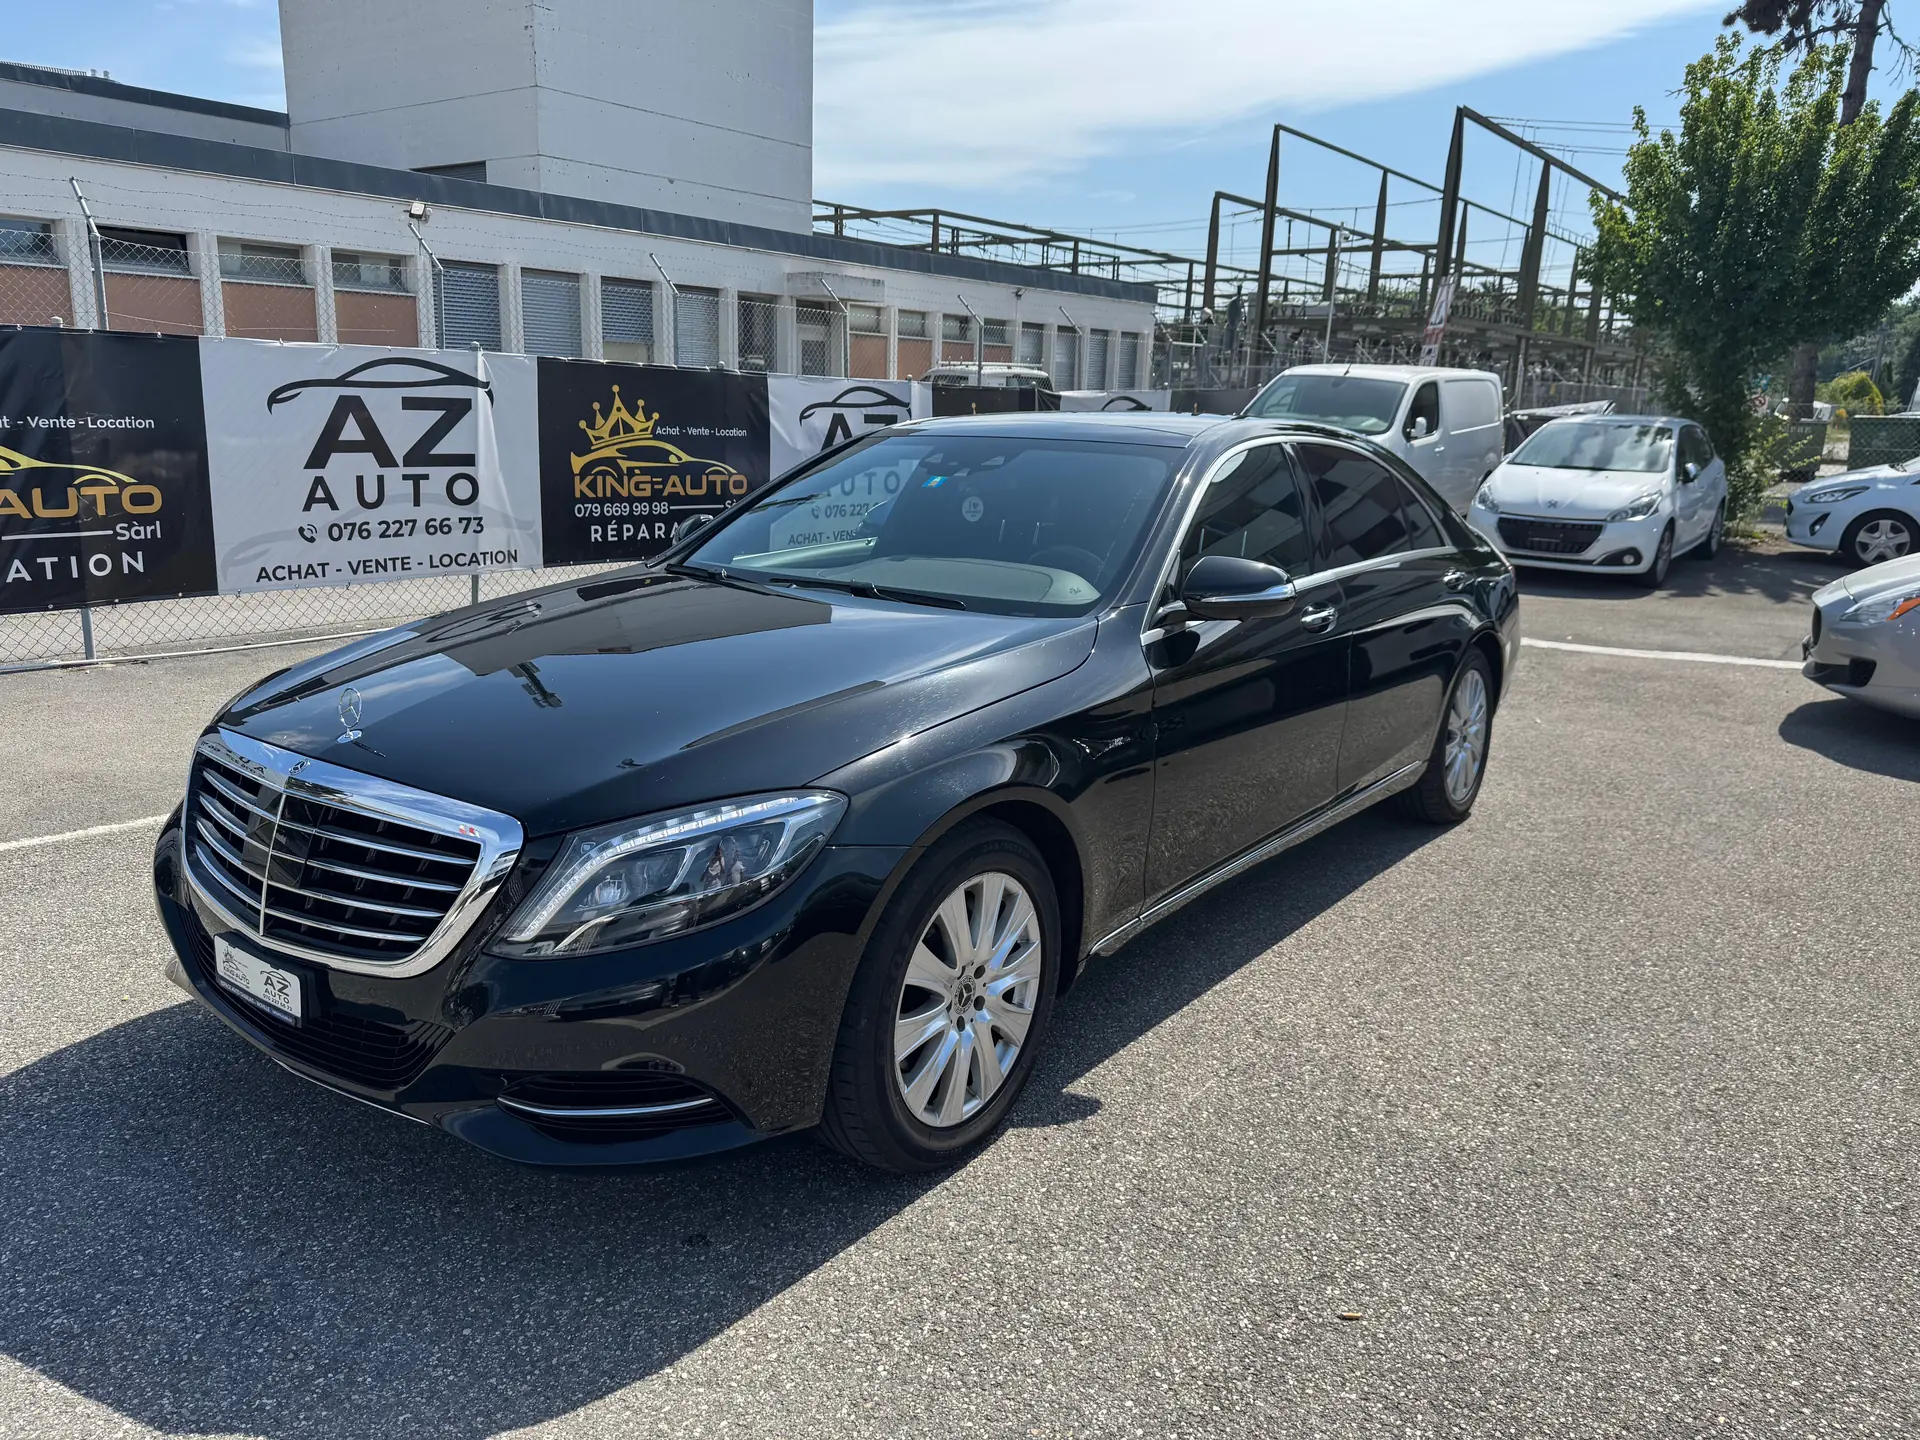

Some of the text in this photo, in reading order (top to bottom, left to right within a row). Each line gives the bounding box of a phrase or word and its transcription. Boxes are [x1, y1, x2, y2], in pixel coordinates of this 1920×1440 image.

[26, 415, 76, 429] Vente
[87, 415, 155, 429] Location
[304, 395, 476, 469] AZ
[655, 426, 680, 435] Achat
[686, 427, 710, 436] Vente
[715, 427, 747, 437] Location
[302, 472, 480, 512] AUTO
[574, 501, 669, 518] 079 669 99 98
[824, 504, 847, 519] 076
[115, 521, 162, 541] Sàrl
[327, 516, 485, 542] 076 227 66 73
[787, 532, 825, 546] ACHAT
[255, 562, 330, 583] ACHAT
[347, 556, 412, 575] VENTE
[429, 549, 518, 569] LOCATION
[263, 975, 290, 997] AZ
[264, 988, 290, 1004] AUTO
